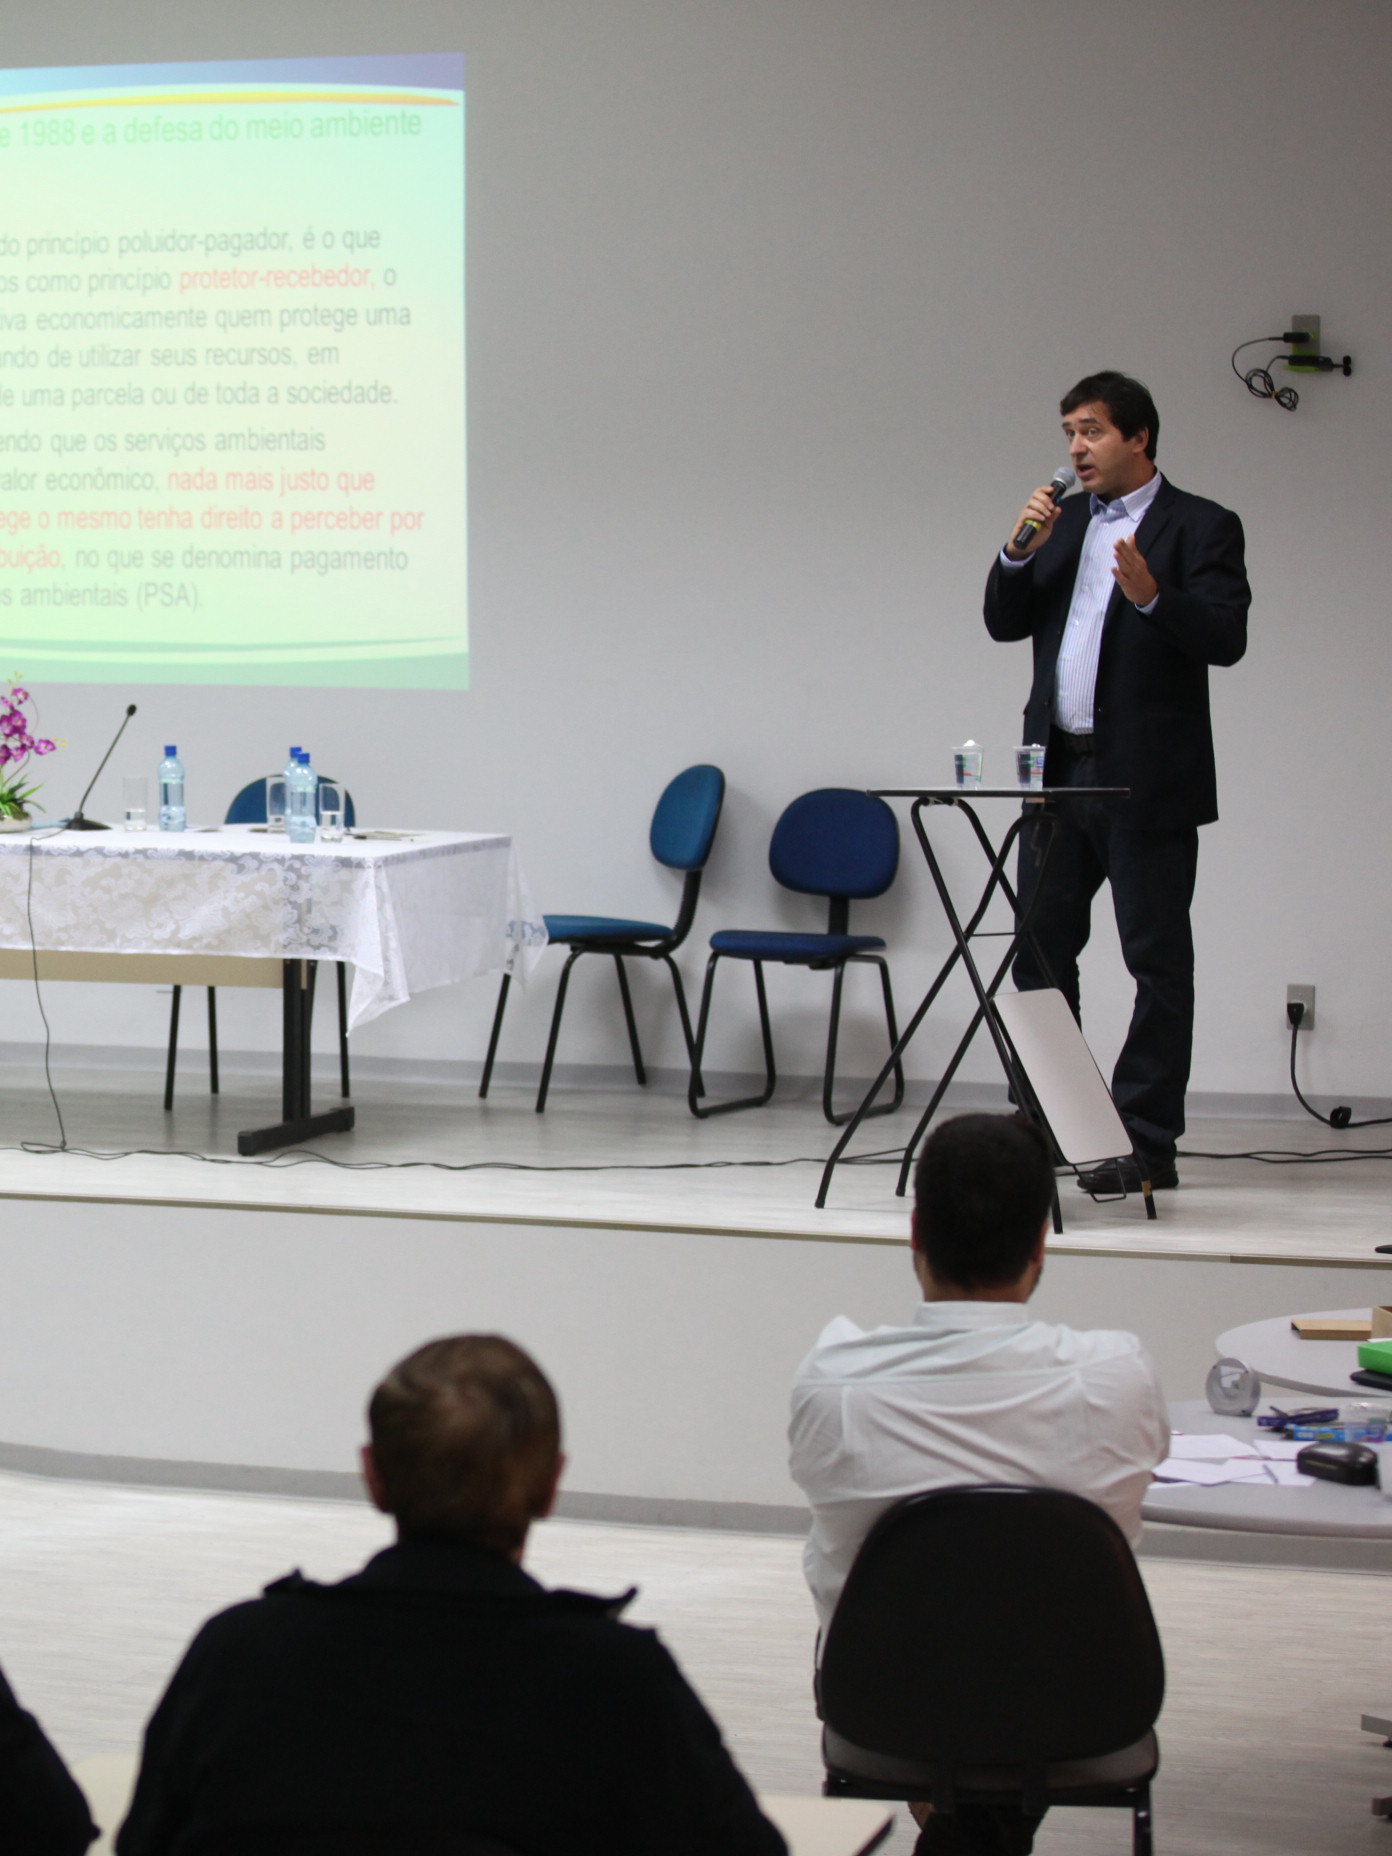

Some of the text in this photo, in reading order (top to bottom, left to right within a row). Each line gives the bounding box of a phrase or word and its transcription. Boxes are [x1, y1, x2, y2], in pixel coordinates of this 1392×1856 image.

[19, 116, 76, 147] 1988
[80, 123, 96, 145] e
[102, 122, 117, 145] a
[123, 112, 204, 144] defesa
[208, 112, 240, 141] do
[244, 111, 305, 140] meio
[311, 106, 425, 138] ambiente
[301, 225, 316, 251] é
[321, 229, 336, 250] o
[341, 229, 382, 256] que
[24, 272, 83, 294] como
[381, 266, 398, 287] o
[34, 305, 208, 332] economicamente
[214, 307, 273, 334] quem
[278, 303, 359, 334] protege
[364, 305, 413, 327] uma
[46, 344, 73, 369] de
[78, 343, 143, 369] utilizar
[150, 346, 198, 368] seus
[306, 345, 340, 366] em
[21, 387, 66, 407] uma
[70, 381, 146, 412] parcela
[150, 385, 178, 406] ou
[182, 380, 210, 406] de
[214, 379, 261, 406] toda
[266, 385, 280, 406] a
[49, 432, 88, 458] que
[93, 432, 118, 453] os
[123, 431, 208, 458] serviços
[213, 427, 327, 452] ambientais
[167, 467, 219, 492] nada
[224, 470, 275, 492] mais
[279, 468, 330, 498] justo
[336, 471, 376, 495] que
[37, 510, 51, 530] o
[57, 510, 132, 530] mesmo
[137, 505, 194, 530] tenha
[200, 506, 263, 530] direito
[270, 510, 284, 531] a
[290, 506, 384, 535] perceber
[389, 510, 426, 536] por
[73, 548, 100, 569] no
[106, 548, 145, 573] que
[150, 548, 175, 569] se
[180, 543, 283, 570] denomina
[289, 545, 409, 577] pagamento
[20, 581, 129, 608] ambientais
